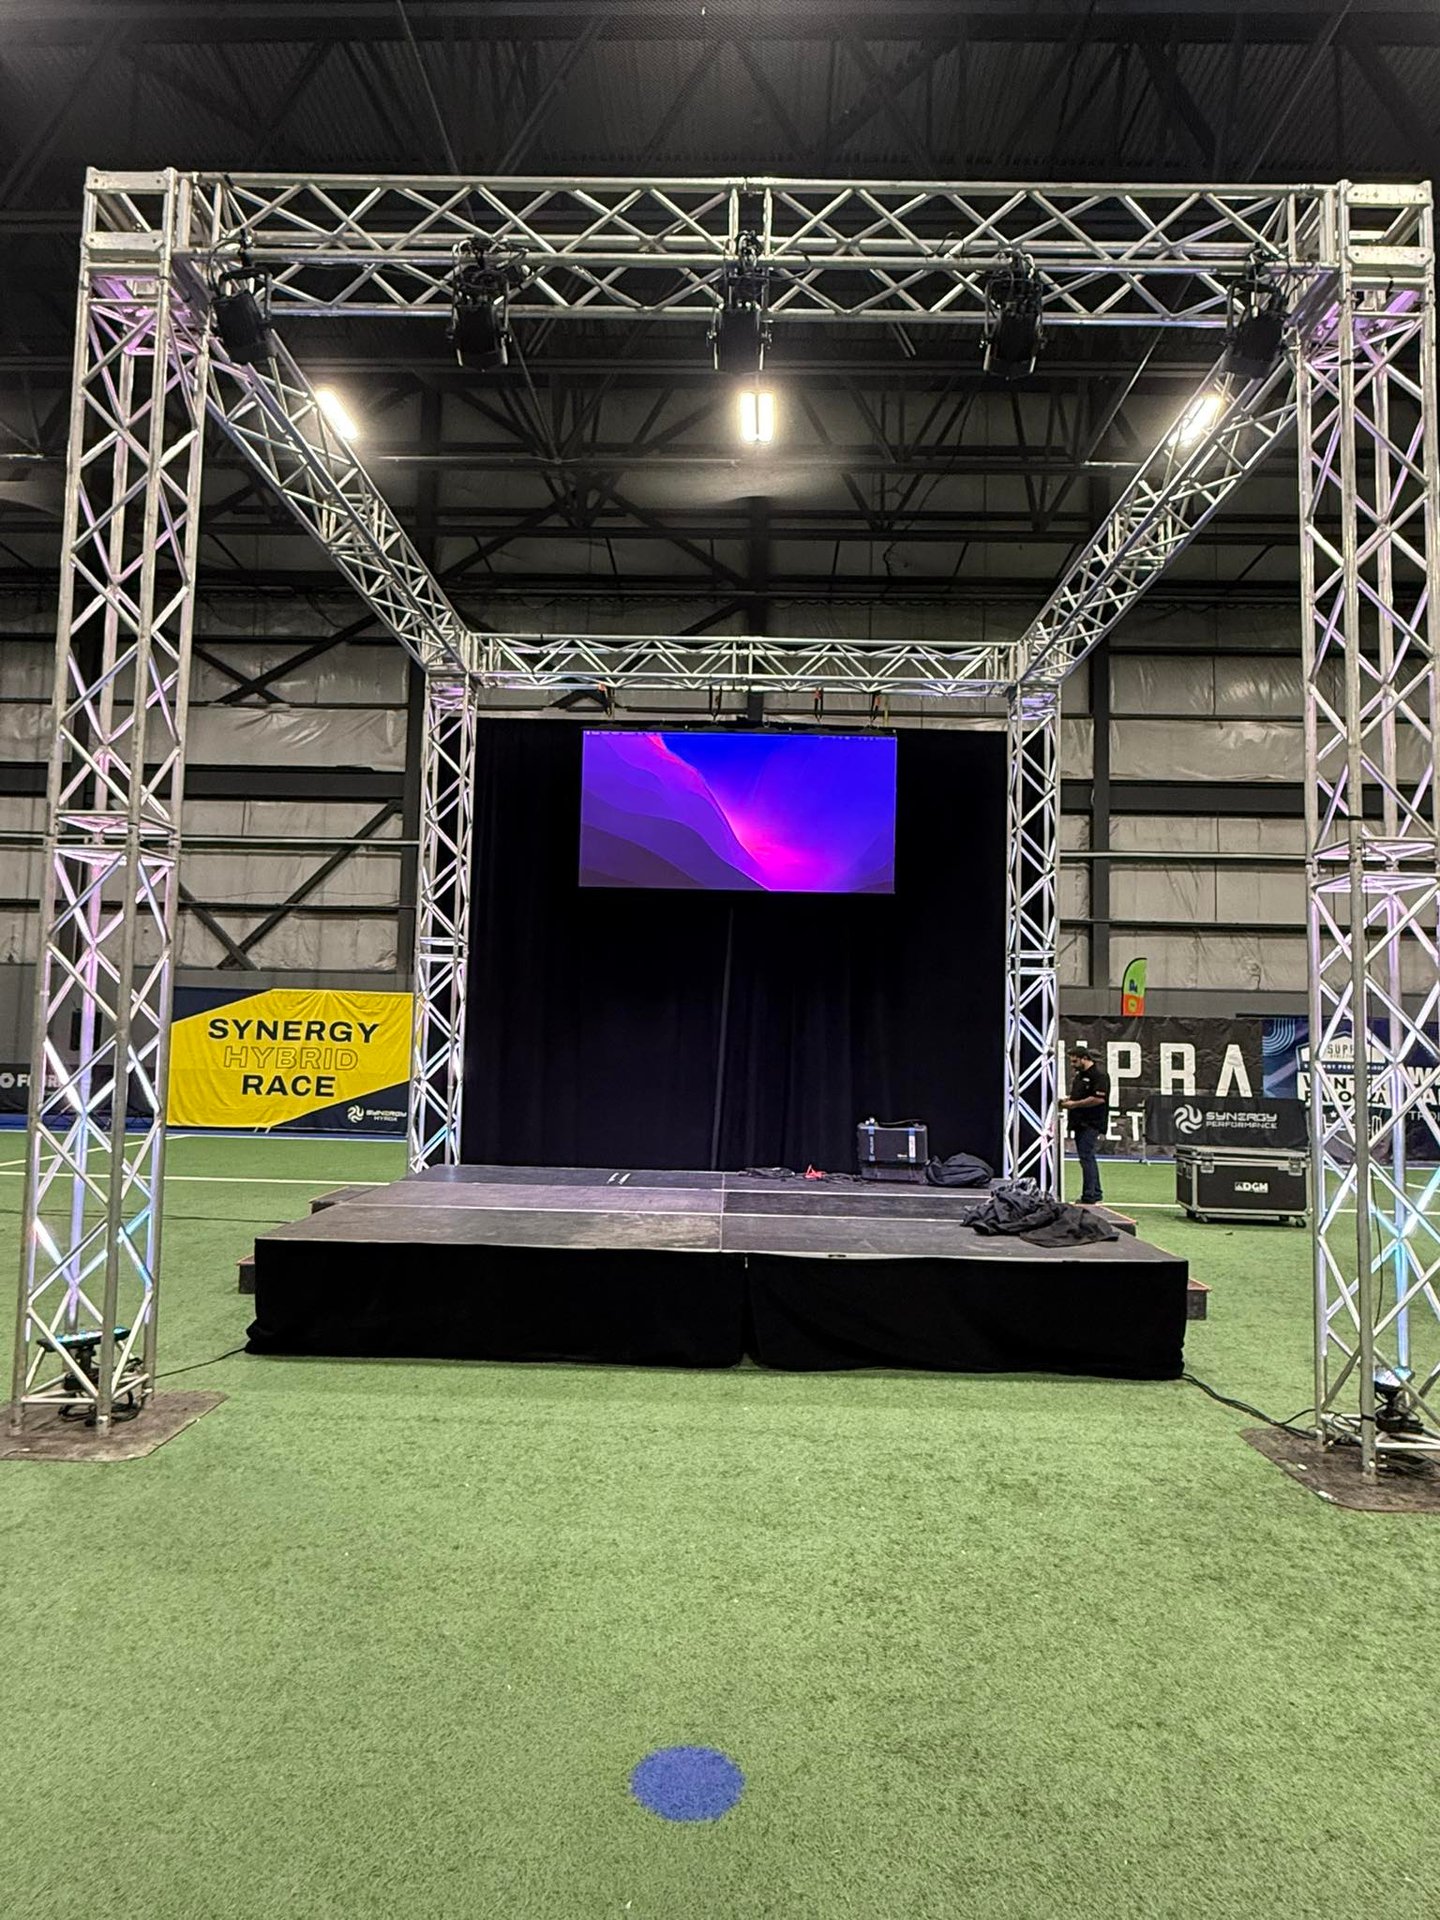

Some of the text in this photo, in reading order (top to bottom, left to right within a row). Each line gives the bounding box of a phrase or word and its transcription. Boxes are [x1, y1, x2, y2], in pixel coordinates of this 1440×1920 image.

[208, 1018, 379, 1043] SYNERGY
[223, 1046, 358, 1070] HYBRID
[242, 1074, 336, 1097] RACE
[1206, 1111, 1278, 1122] SYNERGY
[1206, 1121, 1278, 1129] PERFORMANCE
